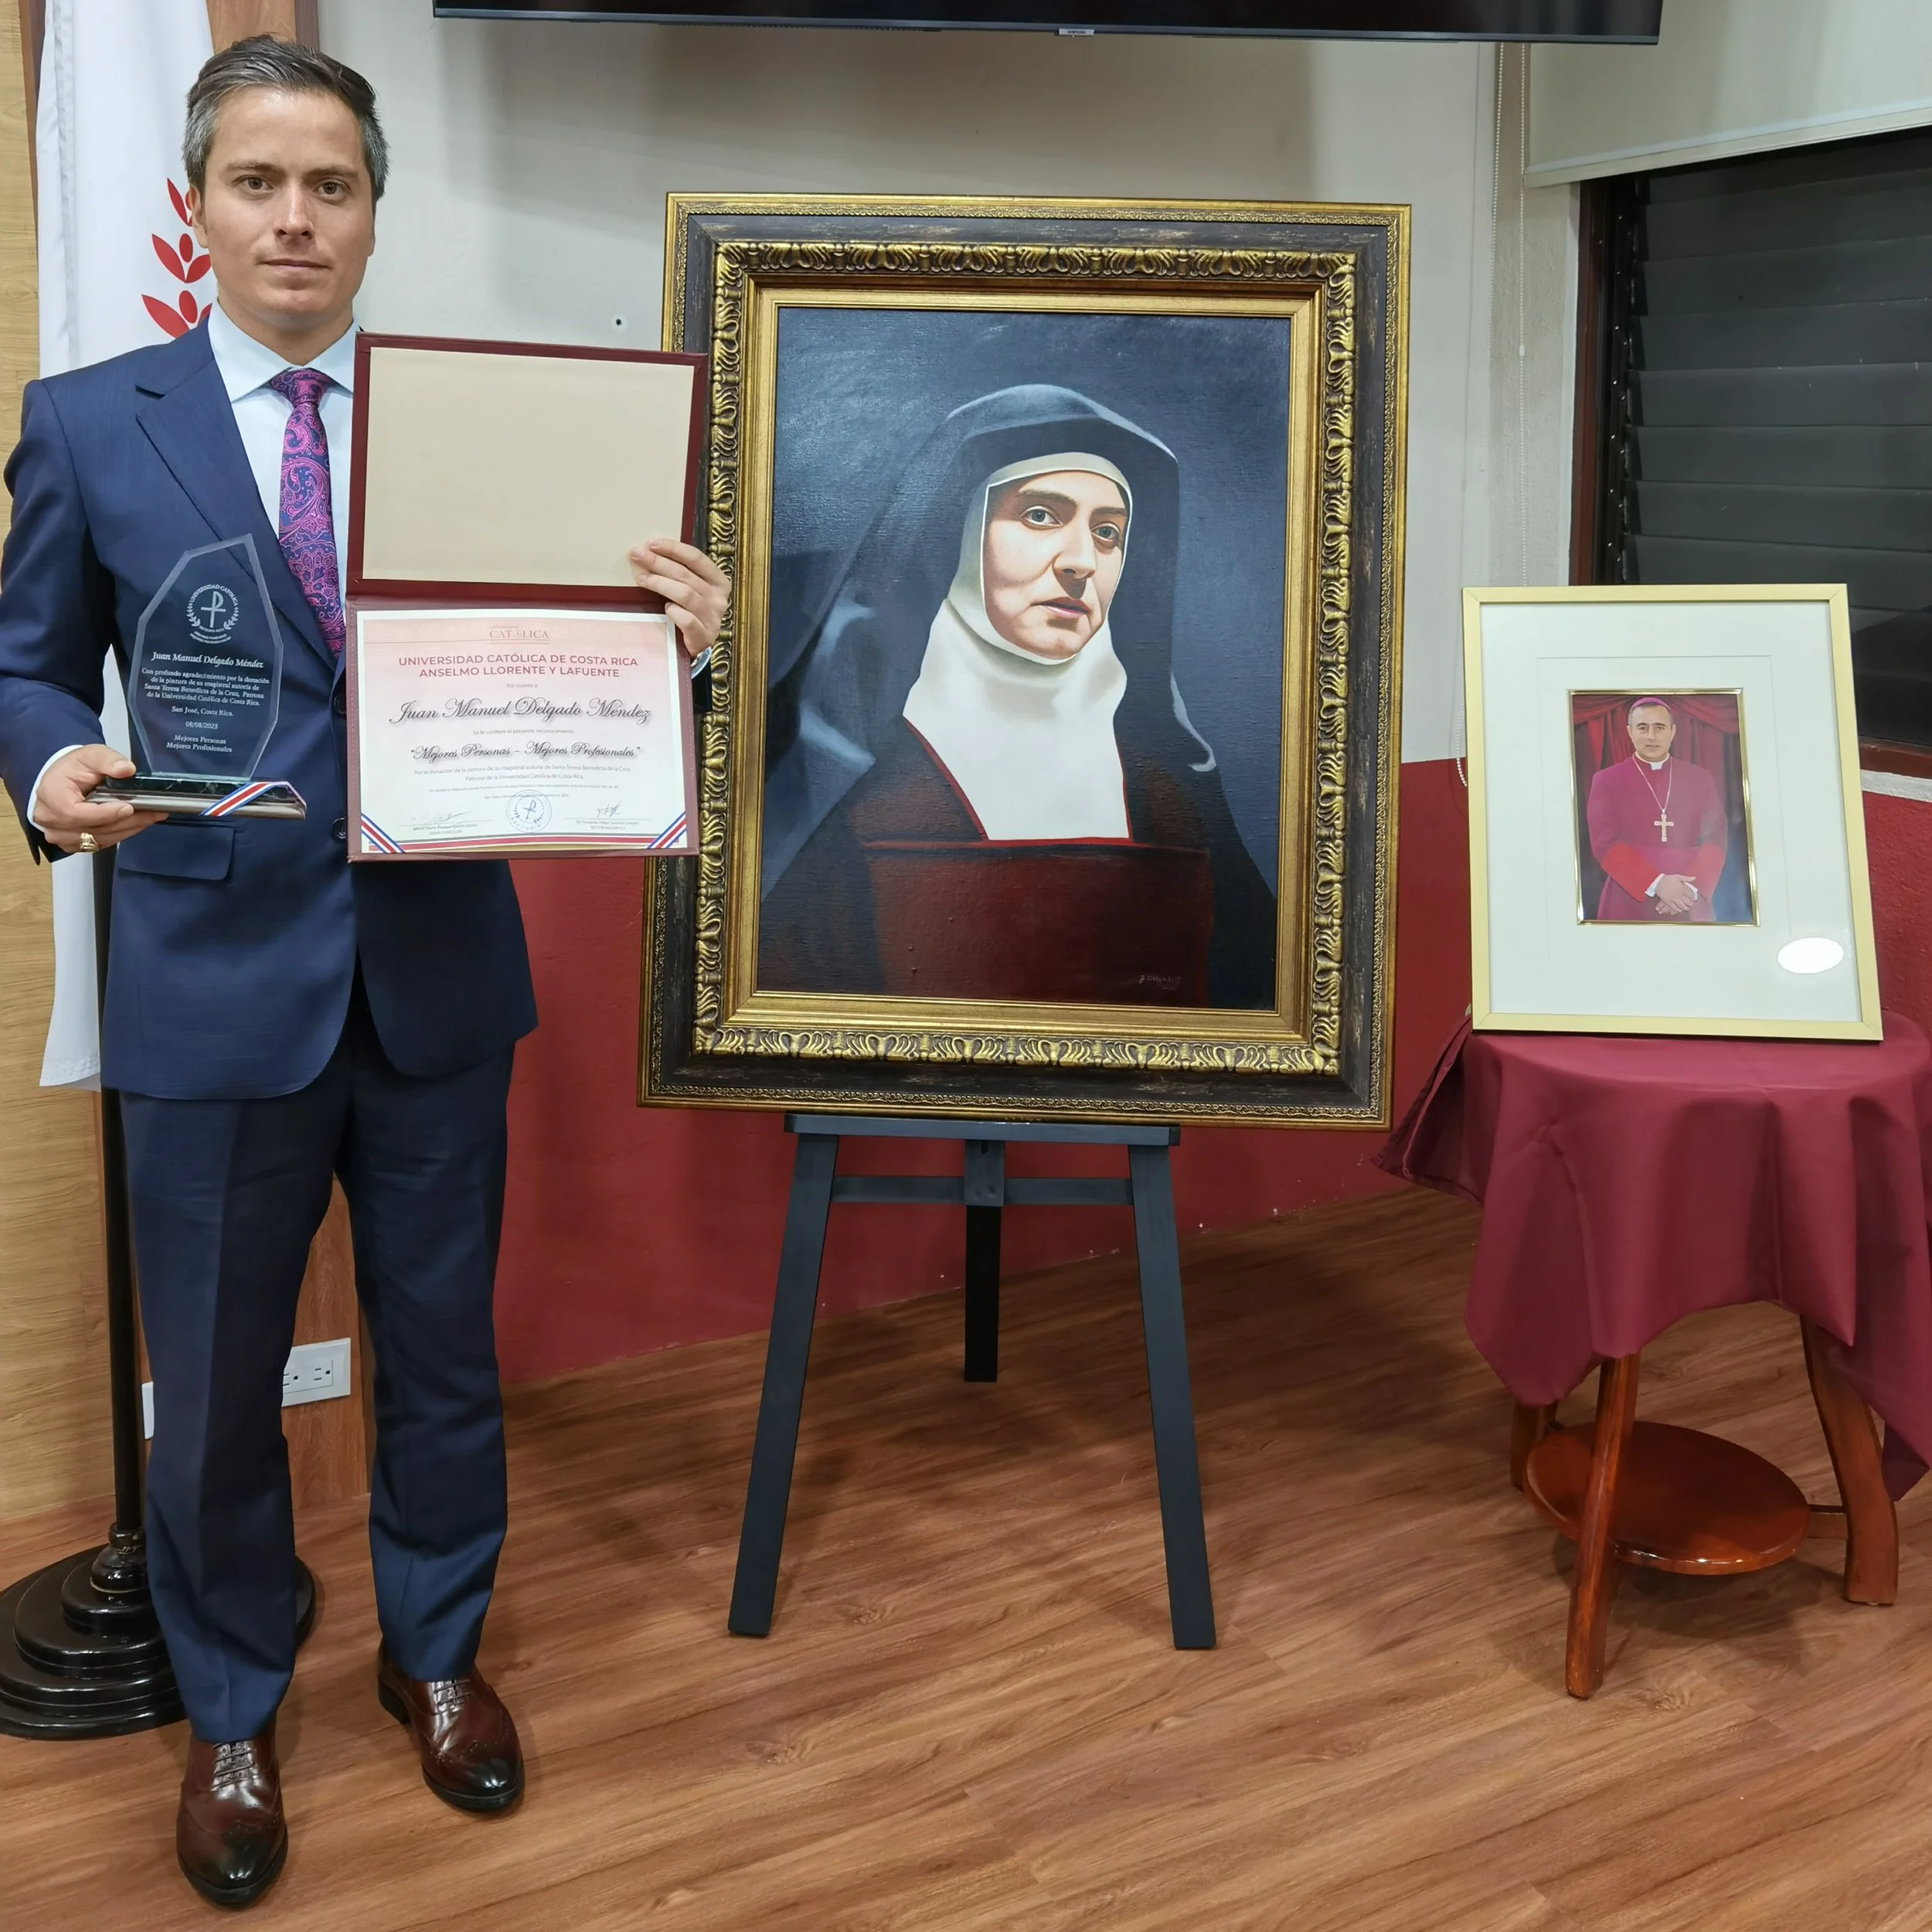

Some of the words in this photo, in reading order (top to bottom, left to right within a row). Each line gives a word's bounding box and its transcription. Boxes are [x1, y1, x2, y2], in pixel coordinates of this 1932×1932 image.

[151, 651, 171, 662] Juan
[172, 654, 203, 663] Manuel
[203, 655, 234, 668] Delgado
[235, 658, 264, 668] Méndez
[399, 655, 483, 666] UNIVERSIDAD
[487, 652, 547, 663] CATÓLICA
[550, 655, 566, 663] DE
[570, 655, 607, 665] COSTA
[611, 658, 638, 666] RICA
[182, 672, 226, 680] agradecimiento
[419, 667, 480, 678] ANSELMO
[483, 666, 546, 675] LLORENTE
[549, 666, 556, 675] Y
[560, 667, 620, 678] LAFUENTE
[162, 692, 196, 701] Universidad
[197, 695, 221, 703] Católica
[389, 699, 438, 724] Juan
[442, 698, 512, 718] Manuel
[513, 696, 582, 723] Delgado
[586, 697, 651, 725] Méndez
[173, 734, 199, 743] Mejores
[200, 736, 226, 744] Personas
[192, 743, 233, 753] Profesionales
[461, 743, 510, 757] Personas
[524, 740, 567, 759] Mejores
